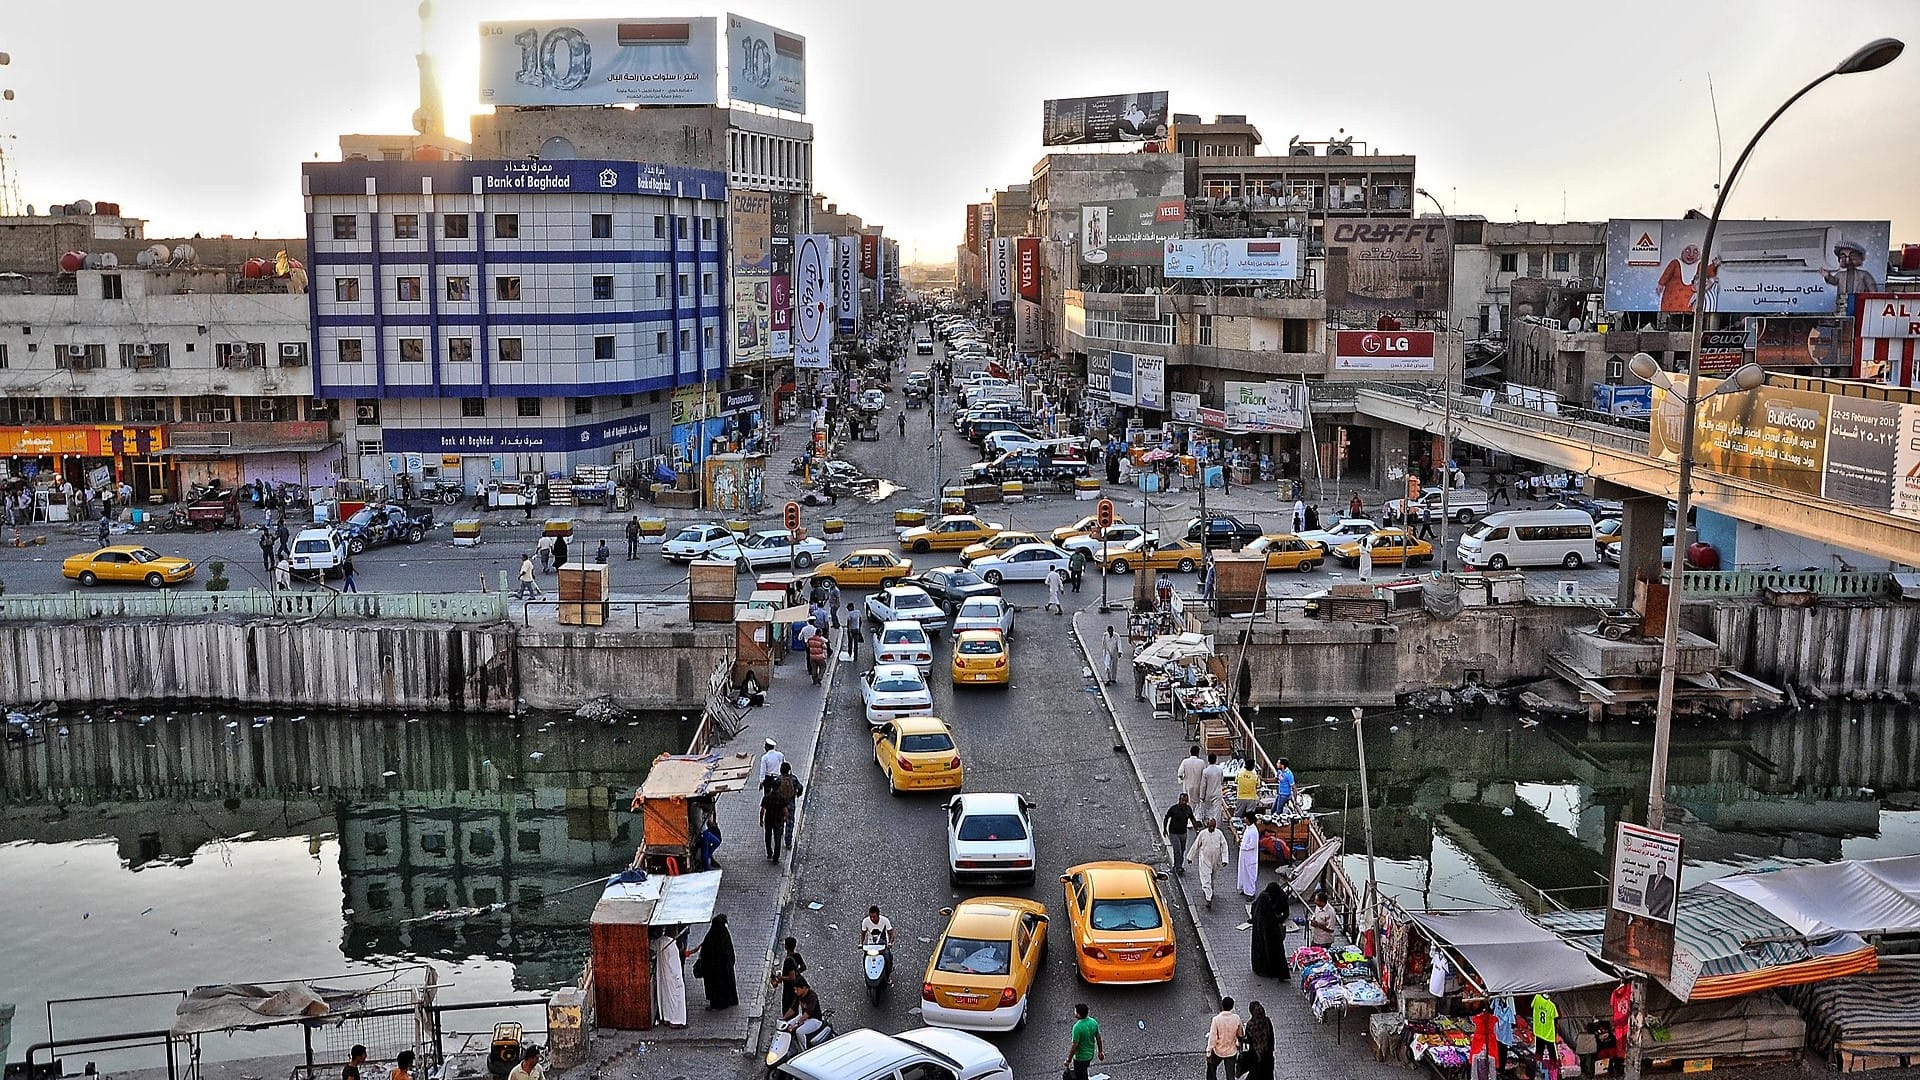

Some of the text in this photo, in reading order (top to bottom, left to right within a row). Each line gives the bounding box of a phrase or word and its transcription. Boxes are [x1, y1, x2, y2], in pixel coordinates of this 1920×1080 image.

[491, 27, 503, 35] LG
[515, 27, 592, 91] 10
[607, 73, 623, 83] البال
[623, 73, 639, 82] راحة
[640, 73, 652, 82] من
[652, 73, 676, 82] سنوات
[683, 73, 699, 82] اشتر
[504, 160, 553, 173] مصرف بغداد
[487, 174, 570, 191] Bank of Baghdad
[653, 178, 671, 192] Baghdad
[1160, 207, 1180, 216] VESTEL
[1175, 244, 1183, 252] LG
[999, 239, 1007, 296] GOSONIC
[1022, 248, 1032, 288] VESTEL
[842, 242, 850, 312] GOSONIC
[1764, 284, 1801, 295] مودك
[1803, 284, 1824, 295] على
[1882, 303, 1911, 317] AL
[774, 309, 786, 325] LG
[1385, 337, 1409, 351] LG
[727, 391, 754, 406] Panasonic
[1767, 409, 1816, 432] BuildExpo
[1832, 410, 1895, 427] 22-25 February 2013
[1831, 423, 1859, 440] شباط
[441, 435, 494, 448] Bank of Baghdad
[500, 434, 543, 447] مصرف بغداد
[1540, 1011, 1546, 1024] 8
